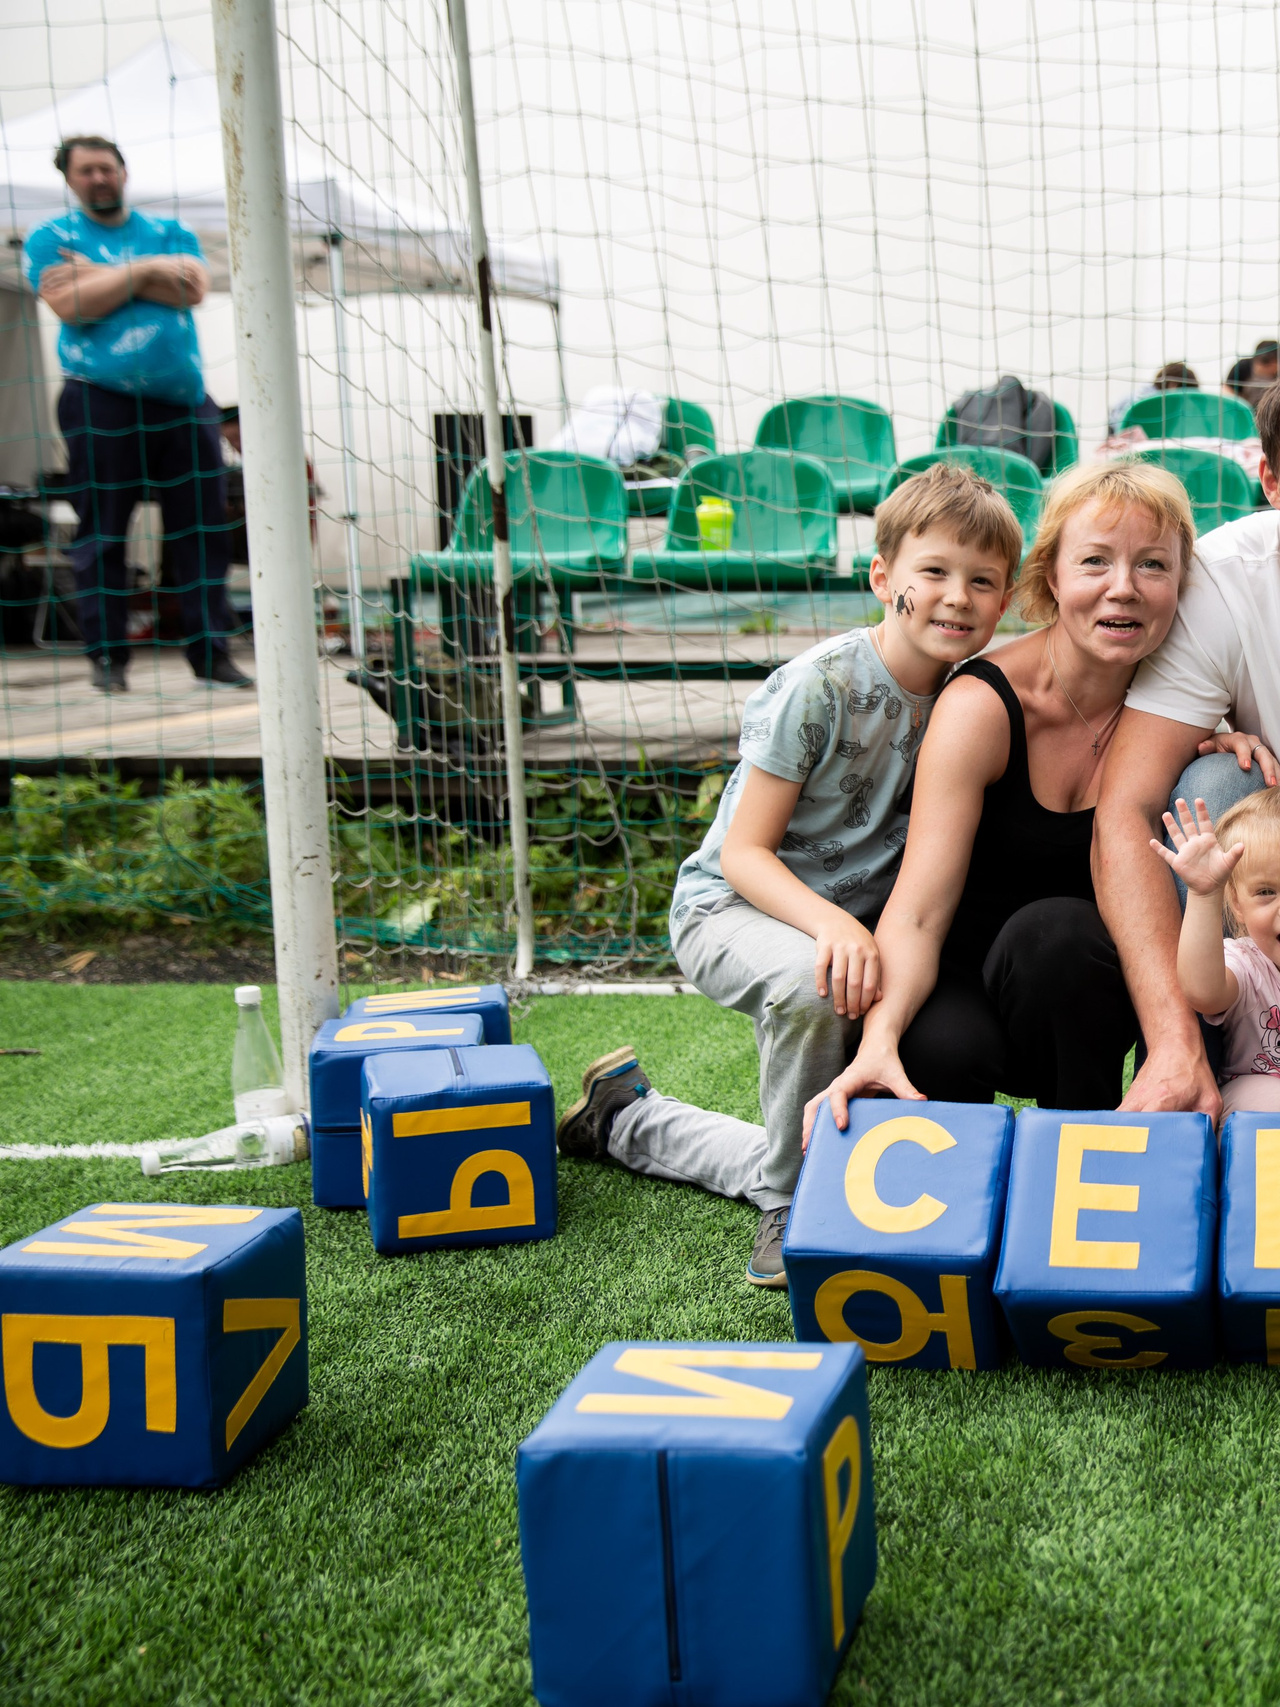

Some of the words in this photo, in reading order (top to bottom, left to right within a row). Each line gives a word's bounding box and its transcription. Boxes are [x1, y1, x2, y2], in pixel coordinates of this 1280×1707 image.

[335, 1022, 462, 1041] Р
[392, 1101, 536, 1239] Ы
[814, 1270, 976, 1370] Ю
[1, 1314, 177, 1449] Б
[575, 1348, 823, 1420] И
[823, 1416, 861, 1650] Р
